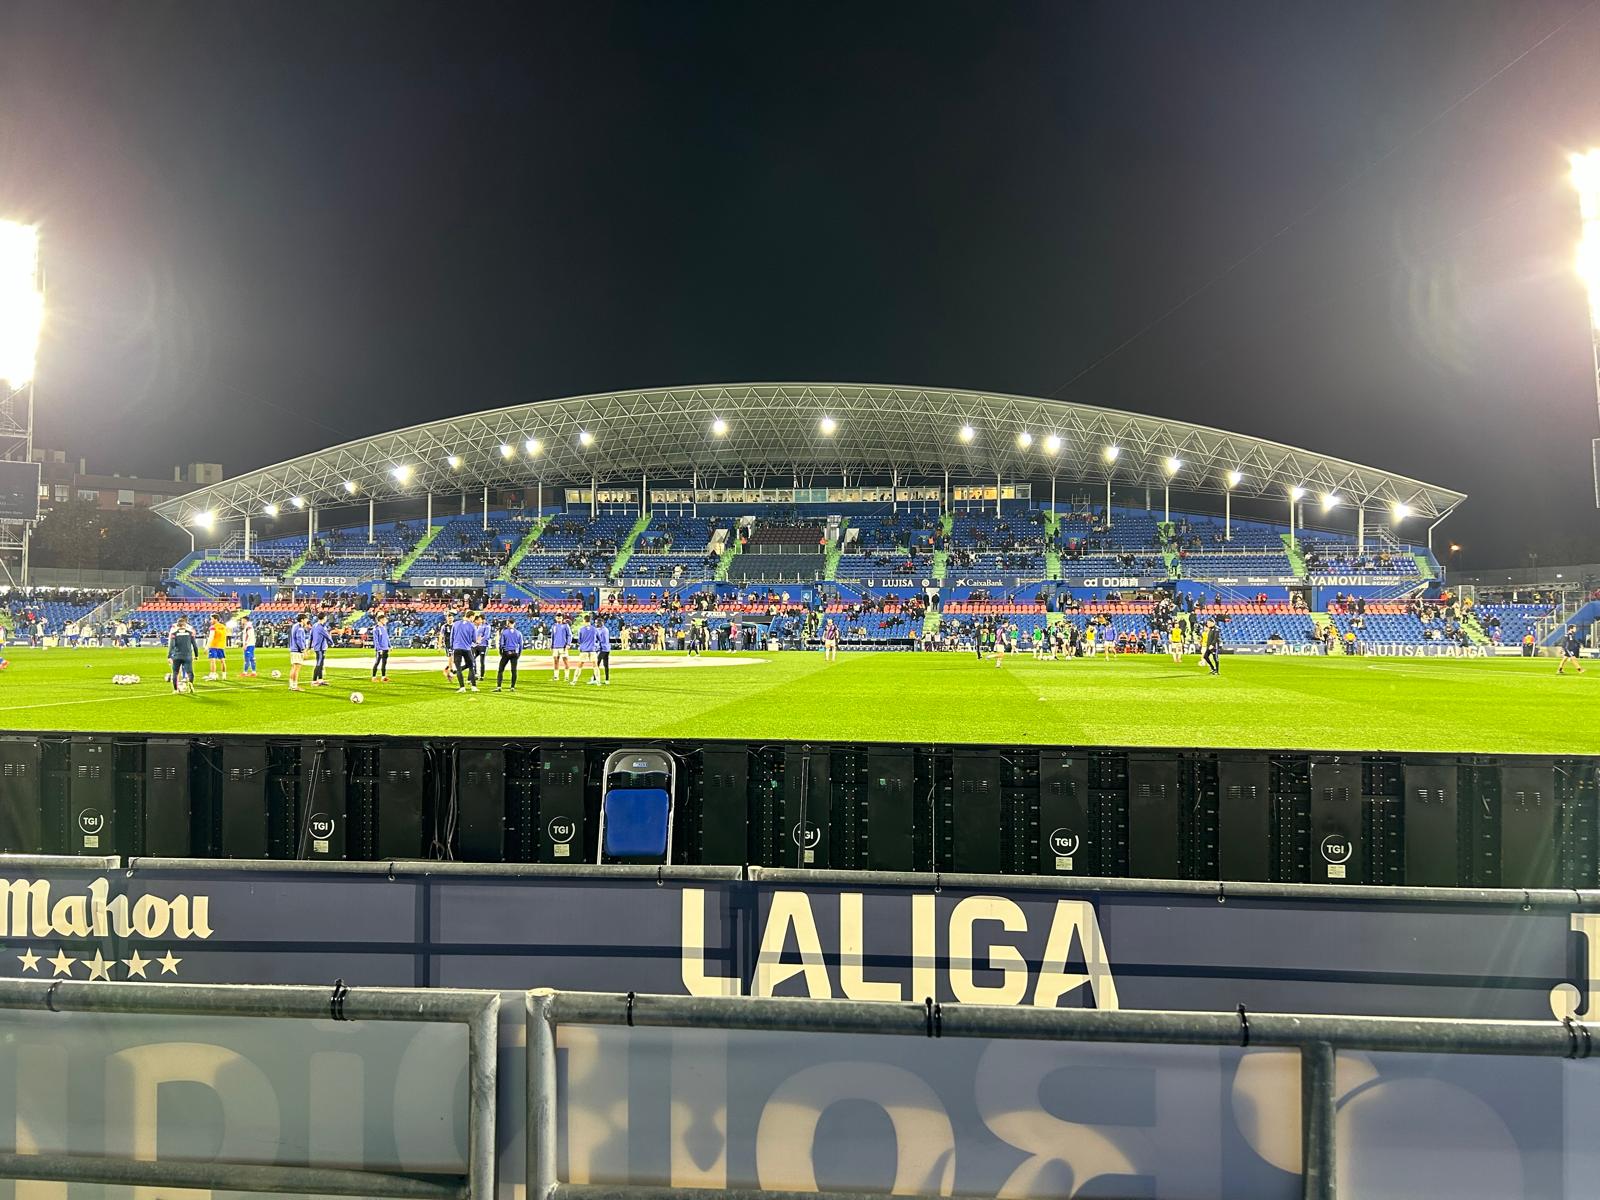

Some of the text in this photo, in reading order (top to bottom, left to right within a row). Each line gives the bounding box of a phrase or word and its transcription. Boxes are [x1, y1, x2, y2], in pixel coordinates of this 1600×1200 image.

[632, 579, 662, 587] LUJISA
[882, 579, 914, 587] LUJISA
[966, 579, 1003, 587] CaixaBank
[1310, 576, 1370, 586] YAMOVIL
[83, 817, 98, 826] TGI
[313, 822, 328, 830] TGI
[553, 826, 568, 834] TGI
[1054, 837, 1071, 846] TGI
[1326, 844, 1345, 853] TGI
[0, 877, 214, 939] Mahou
[681, 887, 1119, 1010] LALIGA
